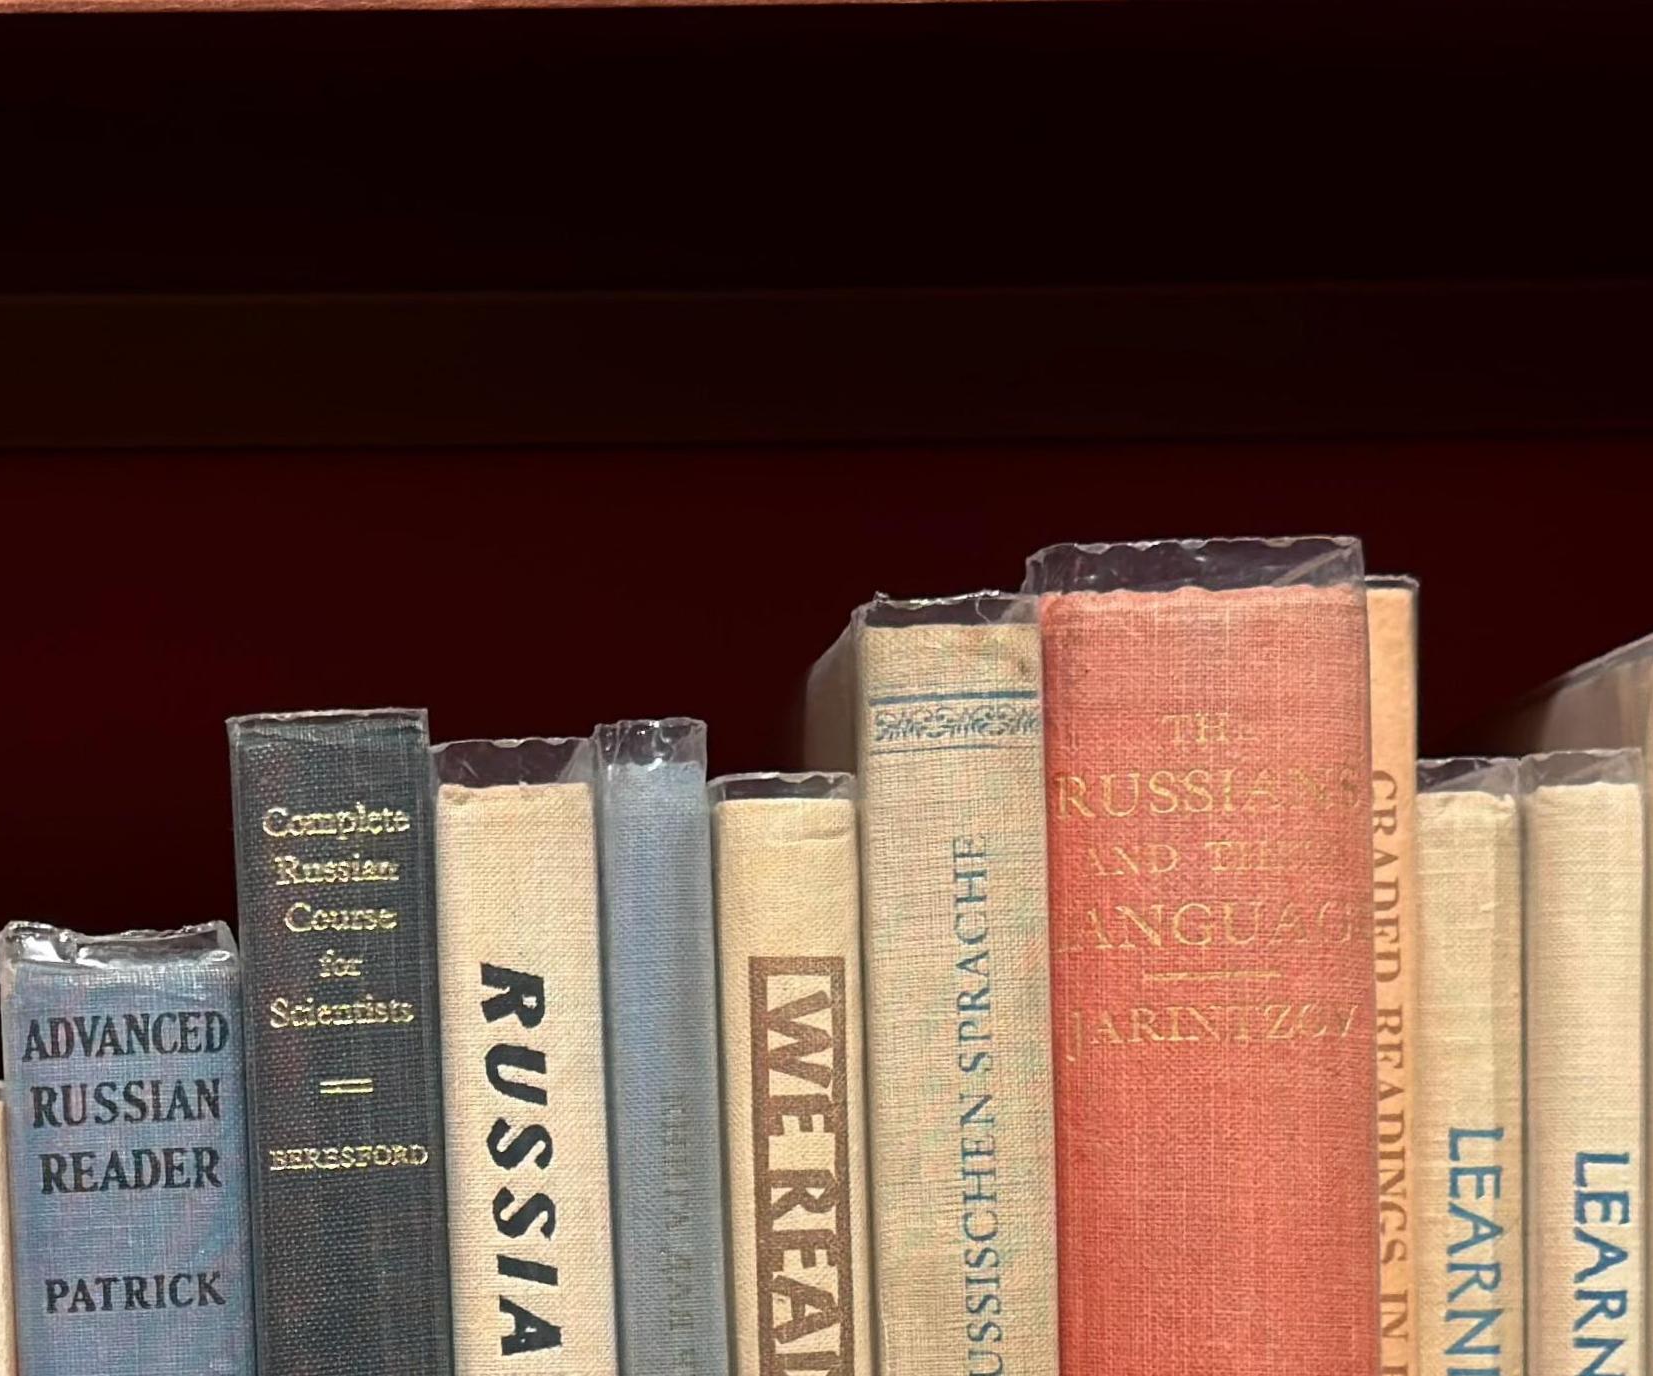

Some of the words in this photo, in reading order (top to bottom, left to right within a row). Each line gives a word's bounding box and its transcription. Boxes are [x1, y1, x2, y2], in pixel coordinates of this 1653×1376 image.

[261, 800, 412, 843] Complete
[273, 853, 401, 887] Russian
[283, 900, 399, 934] Course
[317, 948, 365, 980] for
[952, 834, 993, 1076] SPRACHE
[269, 993, 416, 1030] Scientists
[21, 1009, 231, 1063] ADVANCED
[767, 988, 839, 1137] WE
[30, 1077, 222, 1130] RUSSIAN
[38, 1146, 224, 1196] READER
[268, 1143, 430, 1173] BERESFORD
[44, 1269, 228, 1316] PATRICK
[1382, 1288, 1410, 1346] IN
